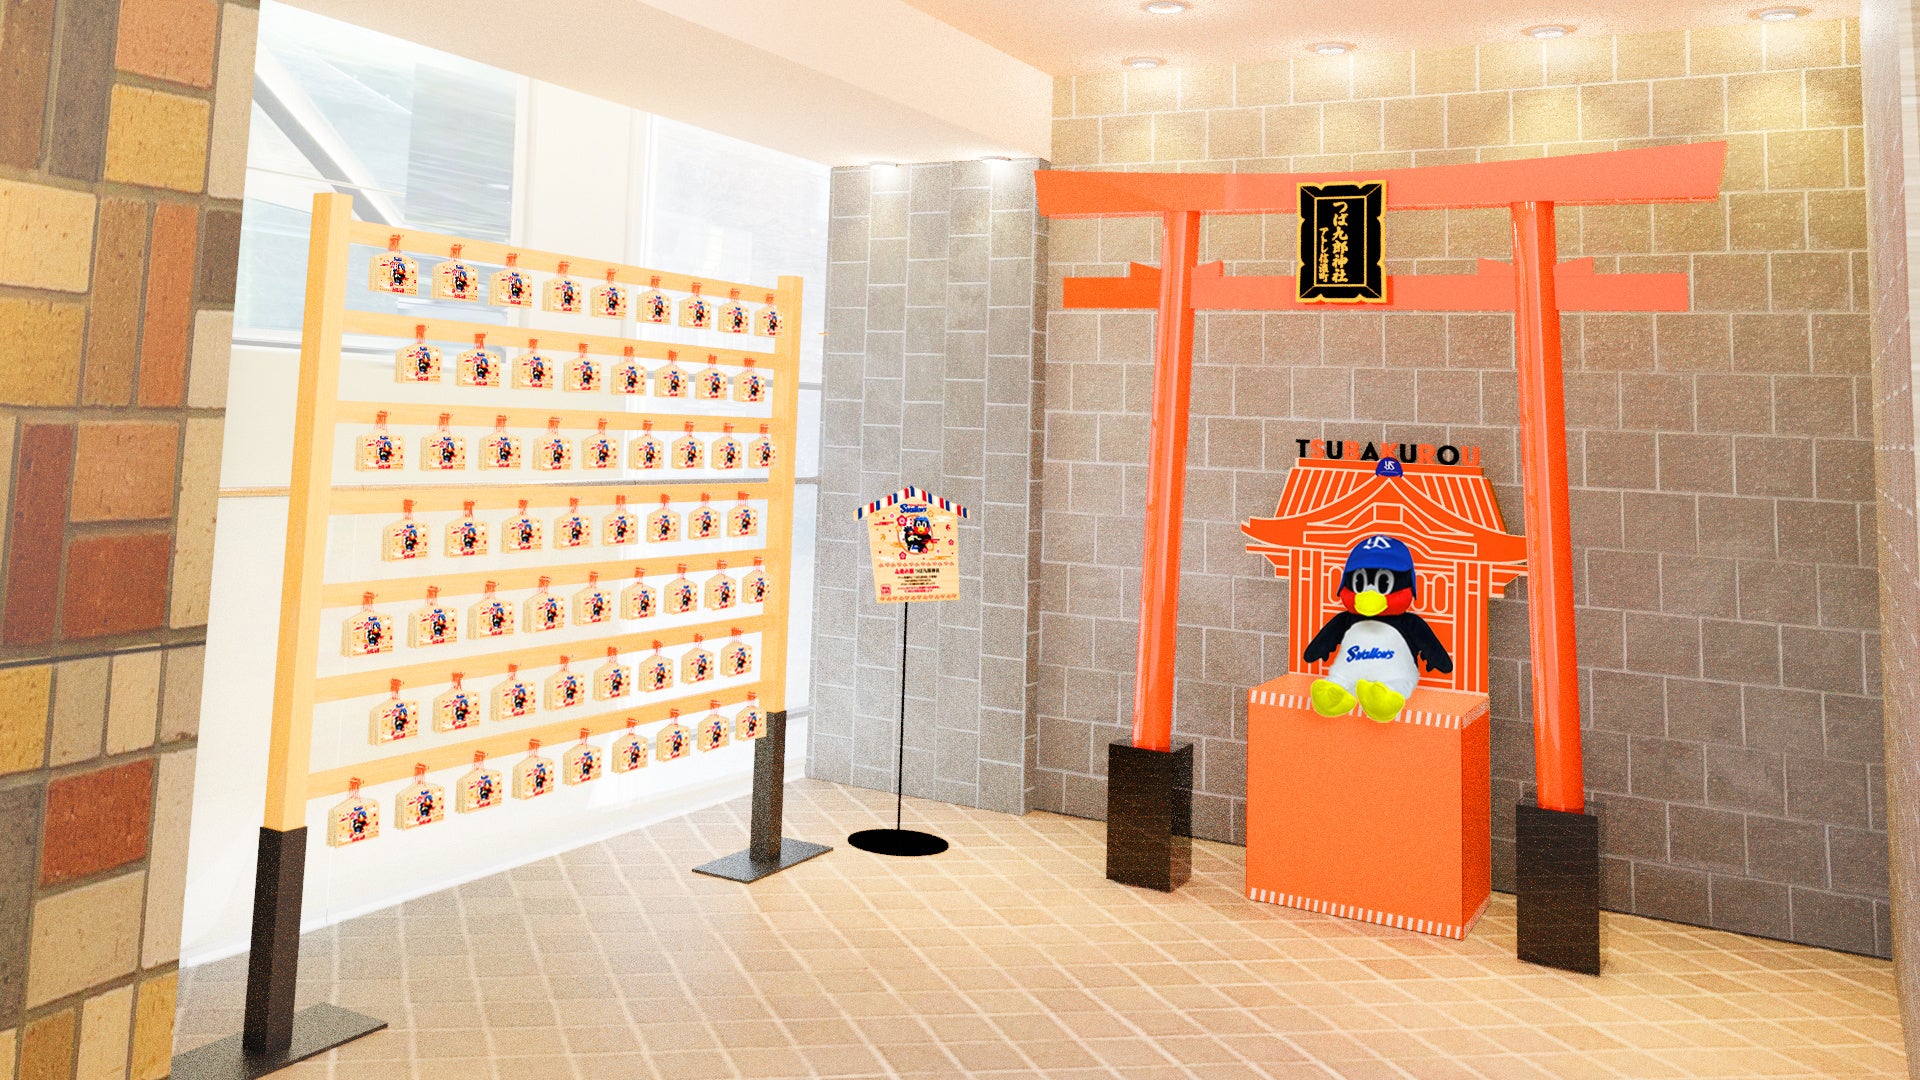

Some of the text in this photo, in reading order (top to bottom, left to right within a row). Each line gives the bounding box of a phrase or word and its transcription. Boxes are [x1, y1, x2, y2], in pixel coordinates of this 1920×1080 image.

[1332, 201, 1348, 283] つば九郎神社
[1297, 438, 1480, 466] TSUBAKUROU
[1346, 645, 1395, 662] Swallows
